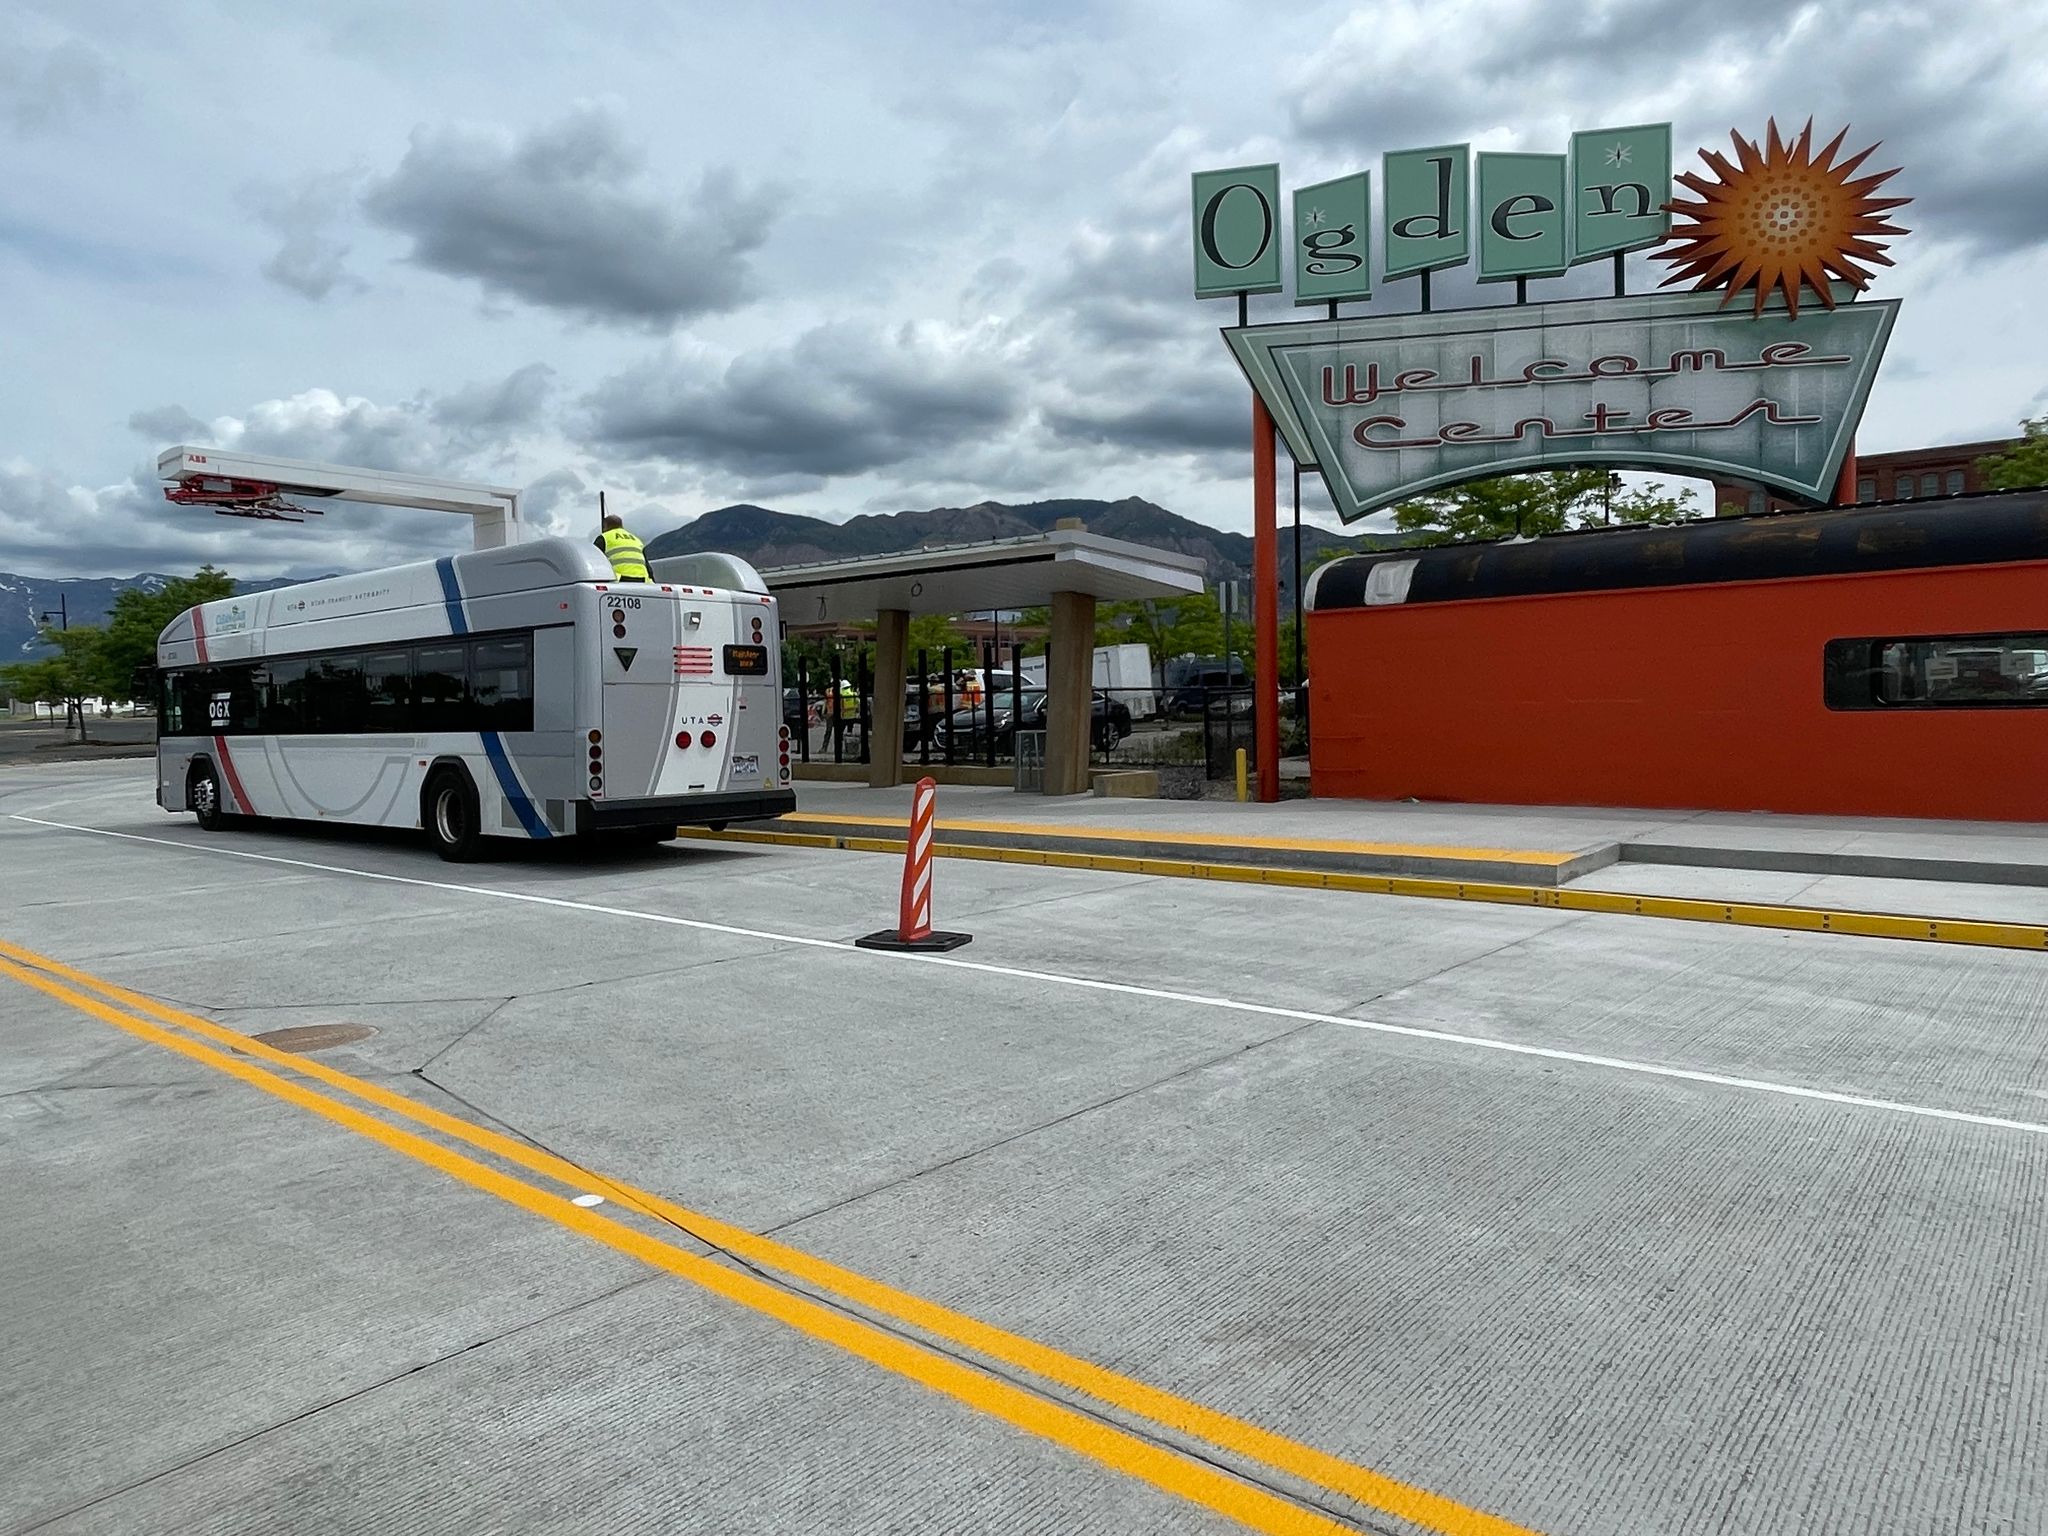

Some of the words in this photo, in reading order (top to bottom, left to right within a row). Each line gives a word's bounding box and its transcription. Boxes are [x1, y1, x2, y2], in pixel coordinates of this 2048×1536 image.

[1200, 156, 1662, 275] Ogden
[1322, 341, 1851, 406] Welcome
[1353, 398, 1821, 450] Center
[607, 596, 641, 609] 22108
[209, 701, 230, 718] OGX
[681, 716, 704, 724] UTA
